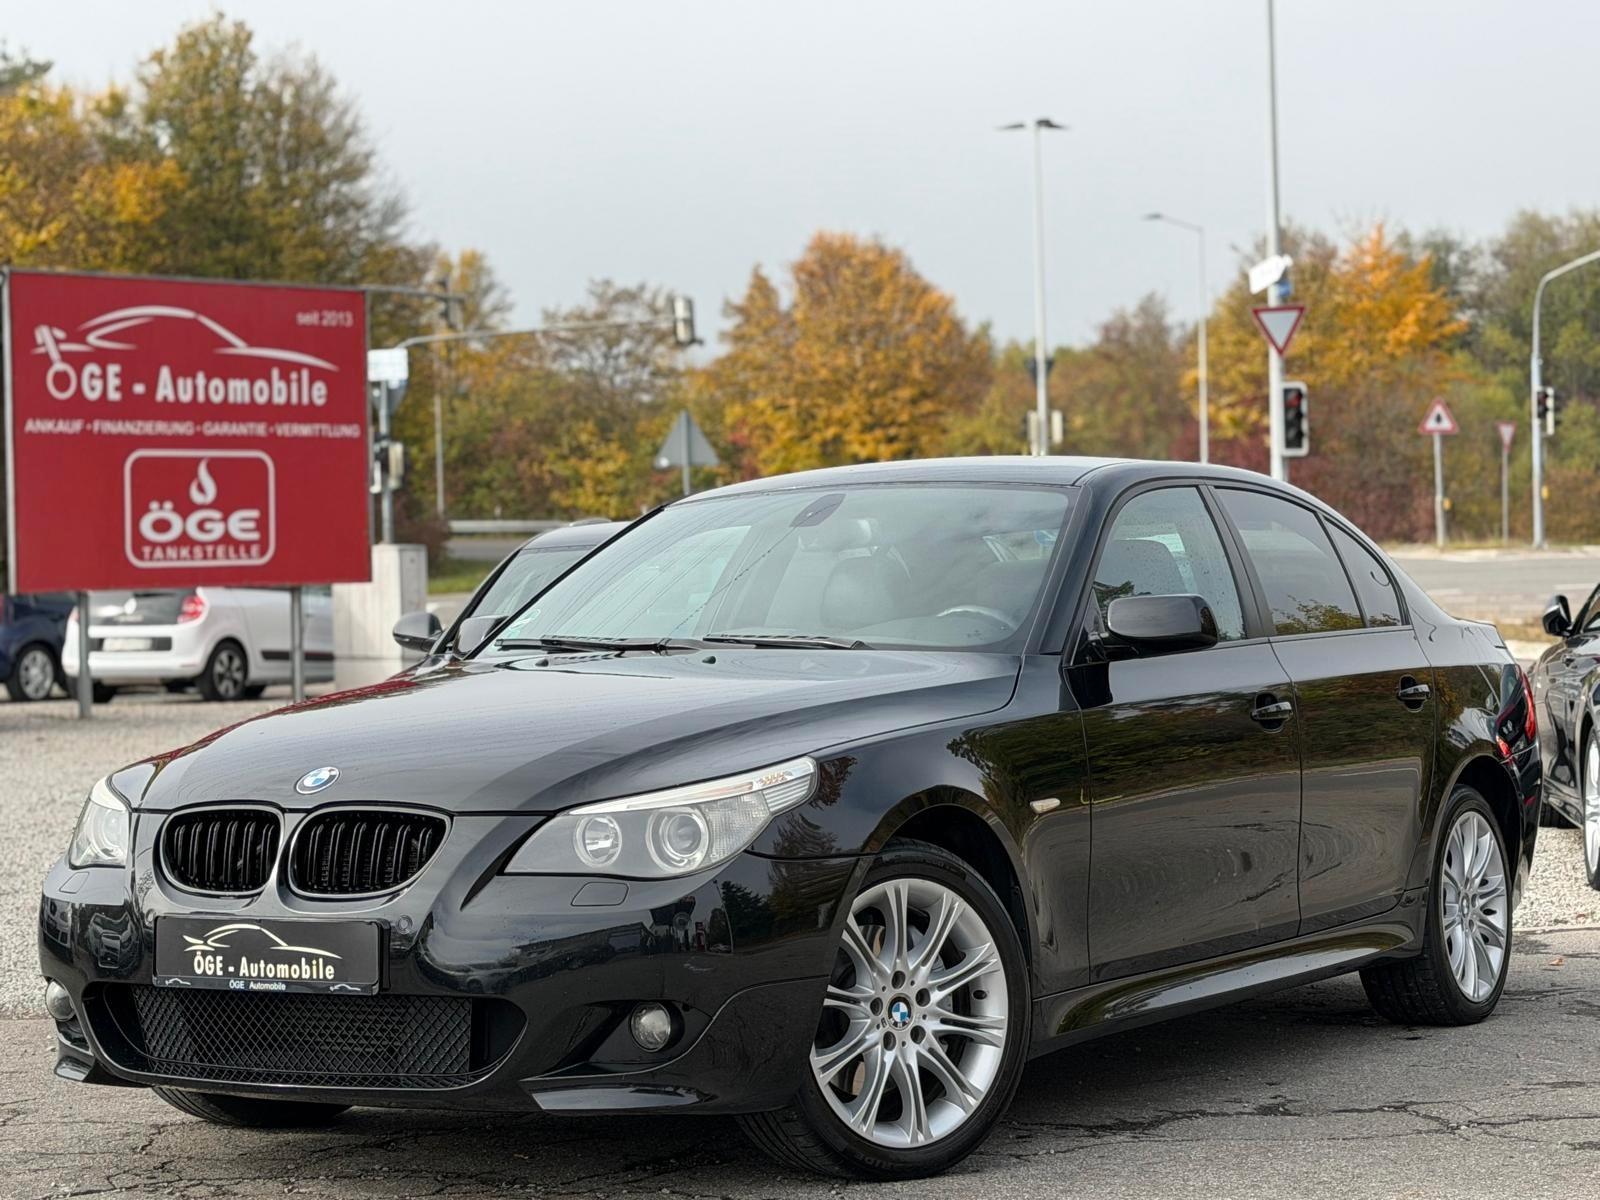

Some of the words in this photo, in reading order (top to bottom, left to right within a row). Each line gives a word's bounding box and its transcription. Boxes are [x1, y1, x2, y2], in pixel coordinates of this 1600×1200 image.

[155, 365, 328, 406] Automobile
[139, 500, 261, 543] ÖGE
[142, 544, 261, 561] TANKSTELLE
[193, 951, 224, 976] ÖGE
[239, 957, 335, 979] Automobile
[229, 978, 245, 990] ÖGE
[249, 981, 286, 991] Automobile
